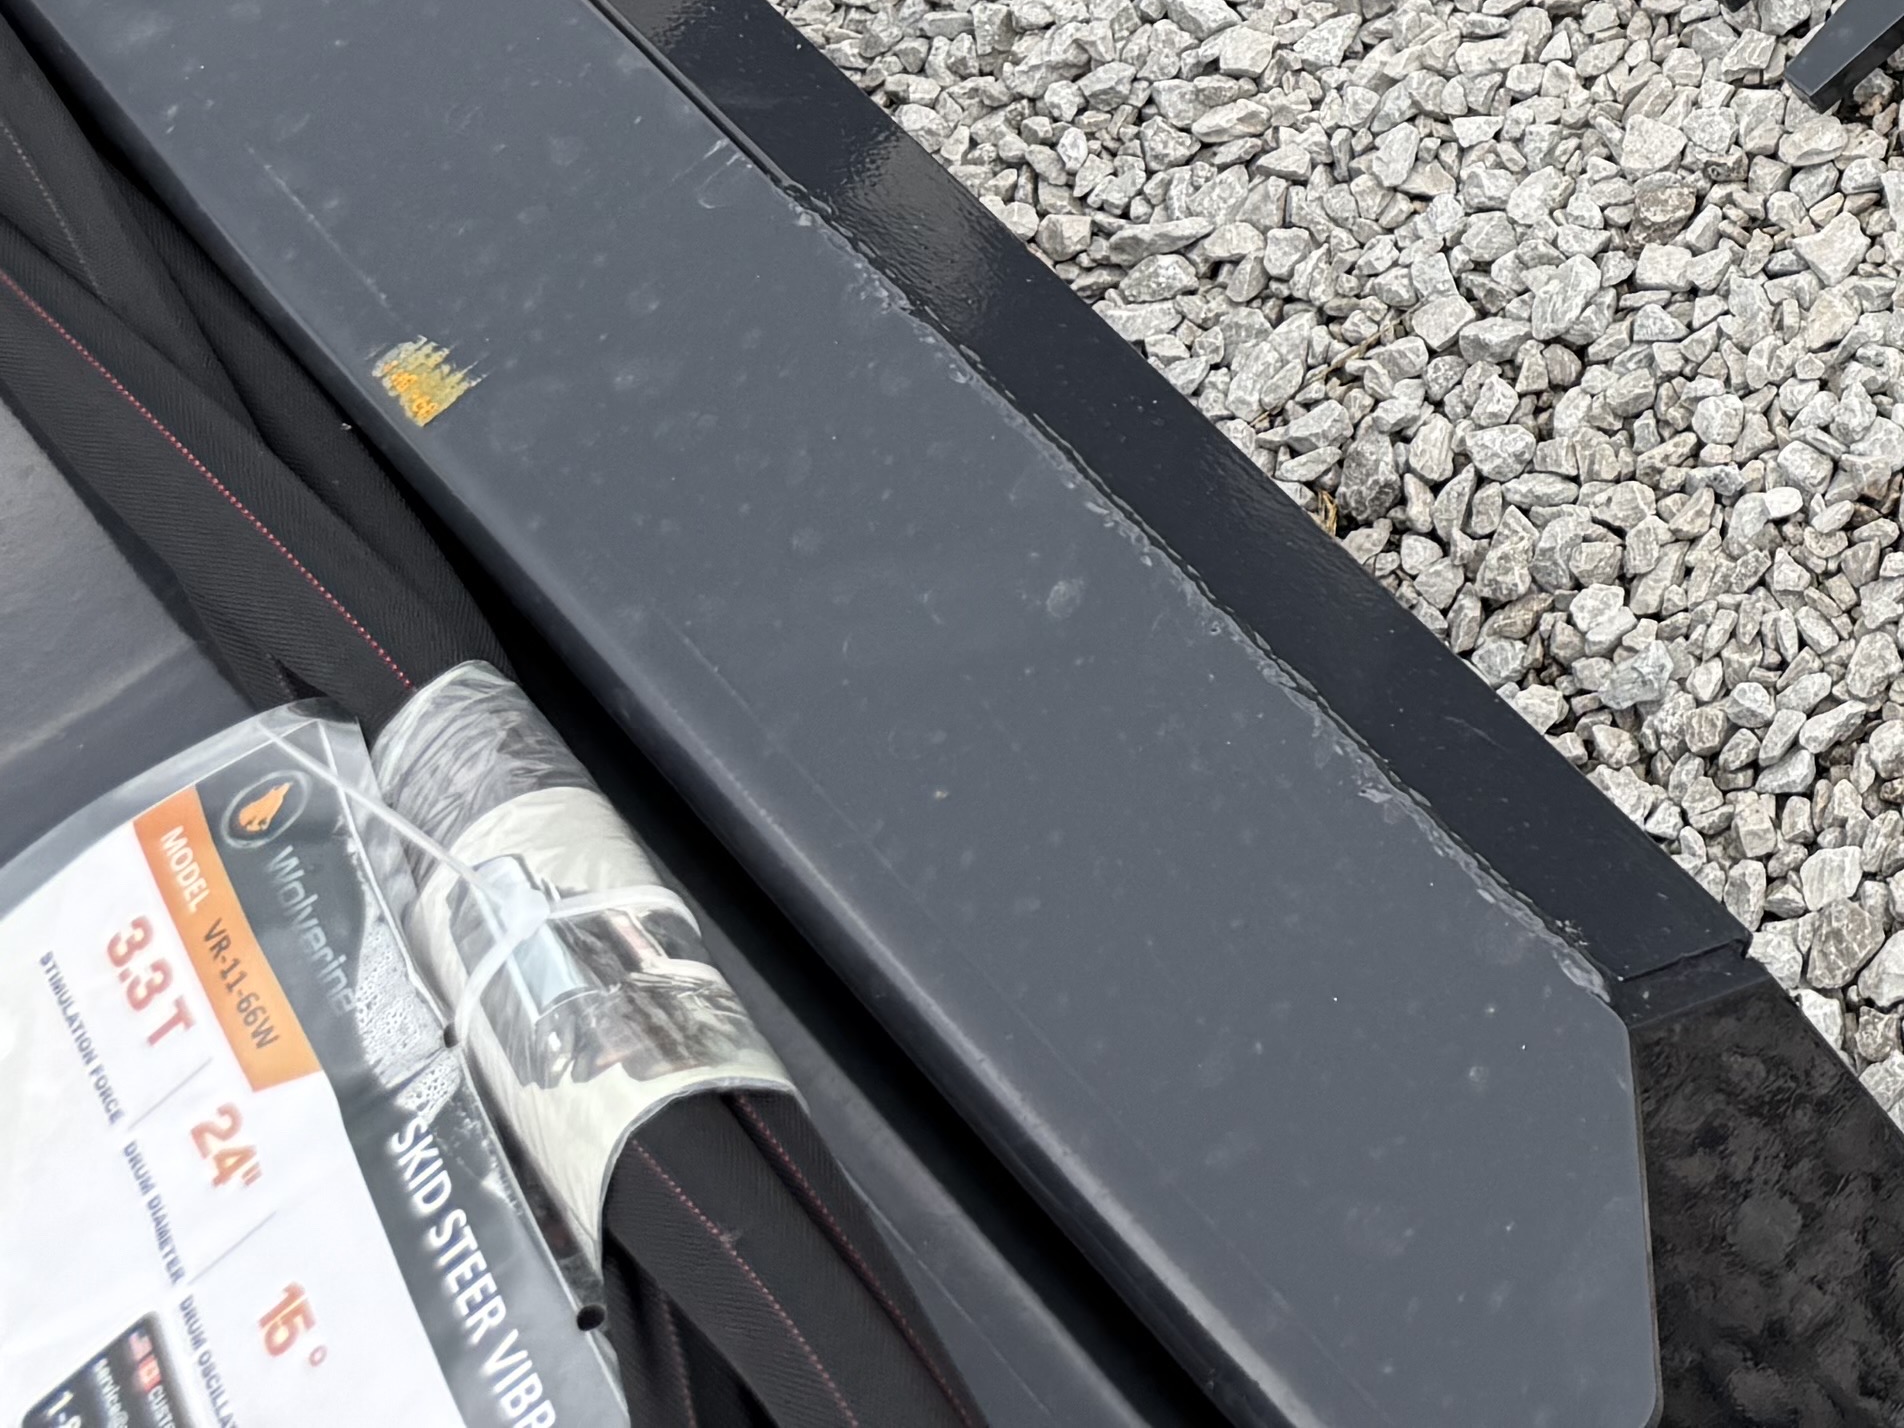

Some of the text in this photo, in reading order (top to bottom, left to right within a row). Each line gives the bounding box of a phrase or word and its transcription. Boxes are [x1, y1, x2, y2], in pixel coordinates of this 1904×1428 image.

[159, 824, 281, 1051] MODEL VR-11-66W
[263, 843, 357, 1016] Wolverine
[40, 951, 124, 1125] STIMULATION FORCE
[123, 1141, 185, 1285] DRUM DIAMETER
[191, 1103, 263, 1189] 24"
[392, 1117, 451, 1215] SKID
[430, 1209, 507, 1345] STEER
[179, 1294, 208, 1351] DRUM
